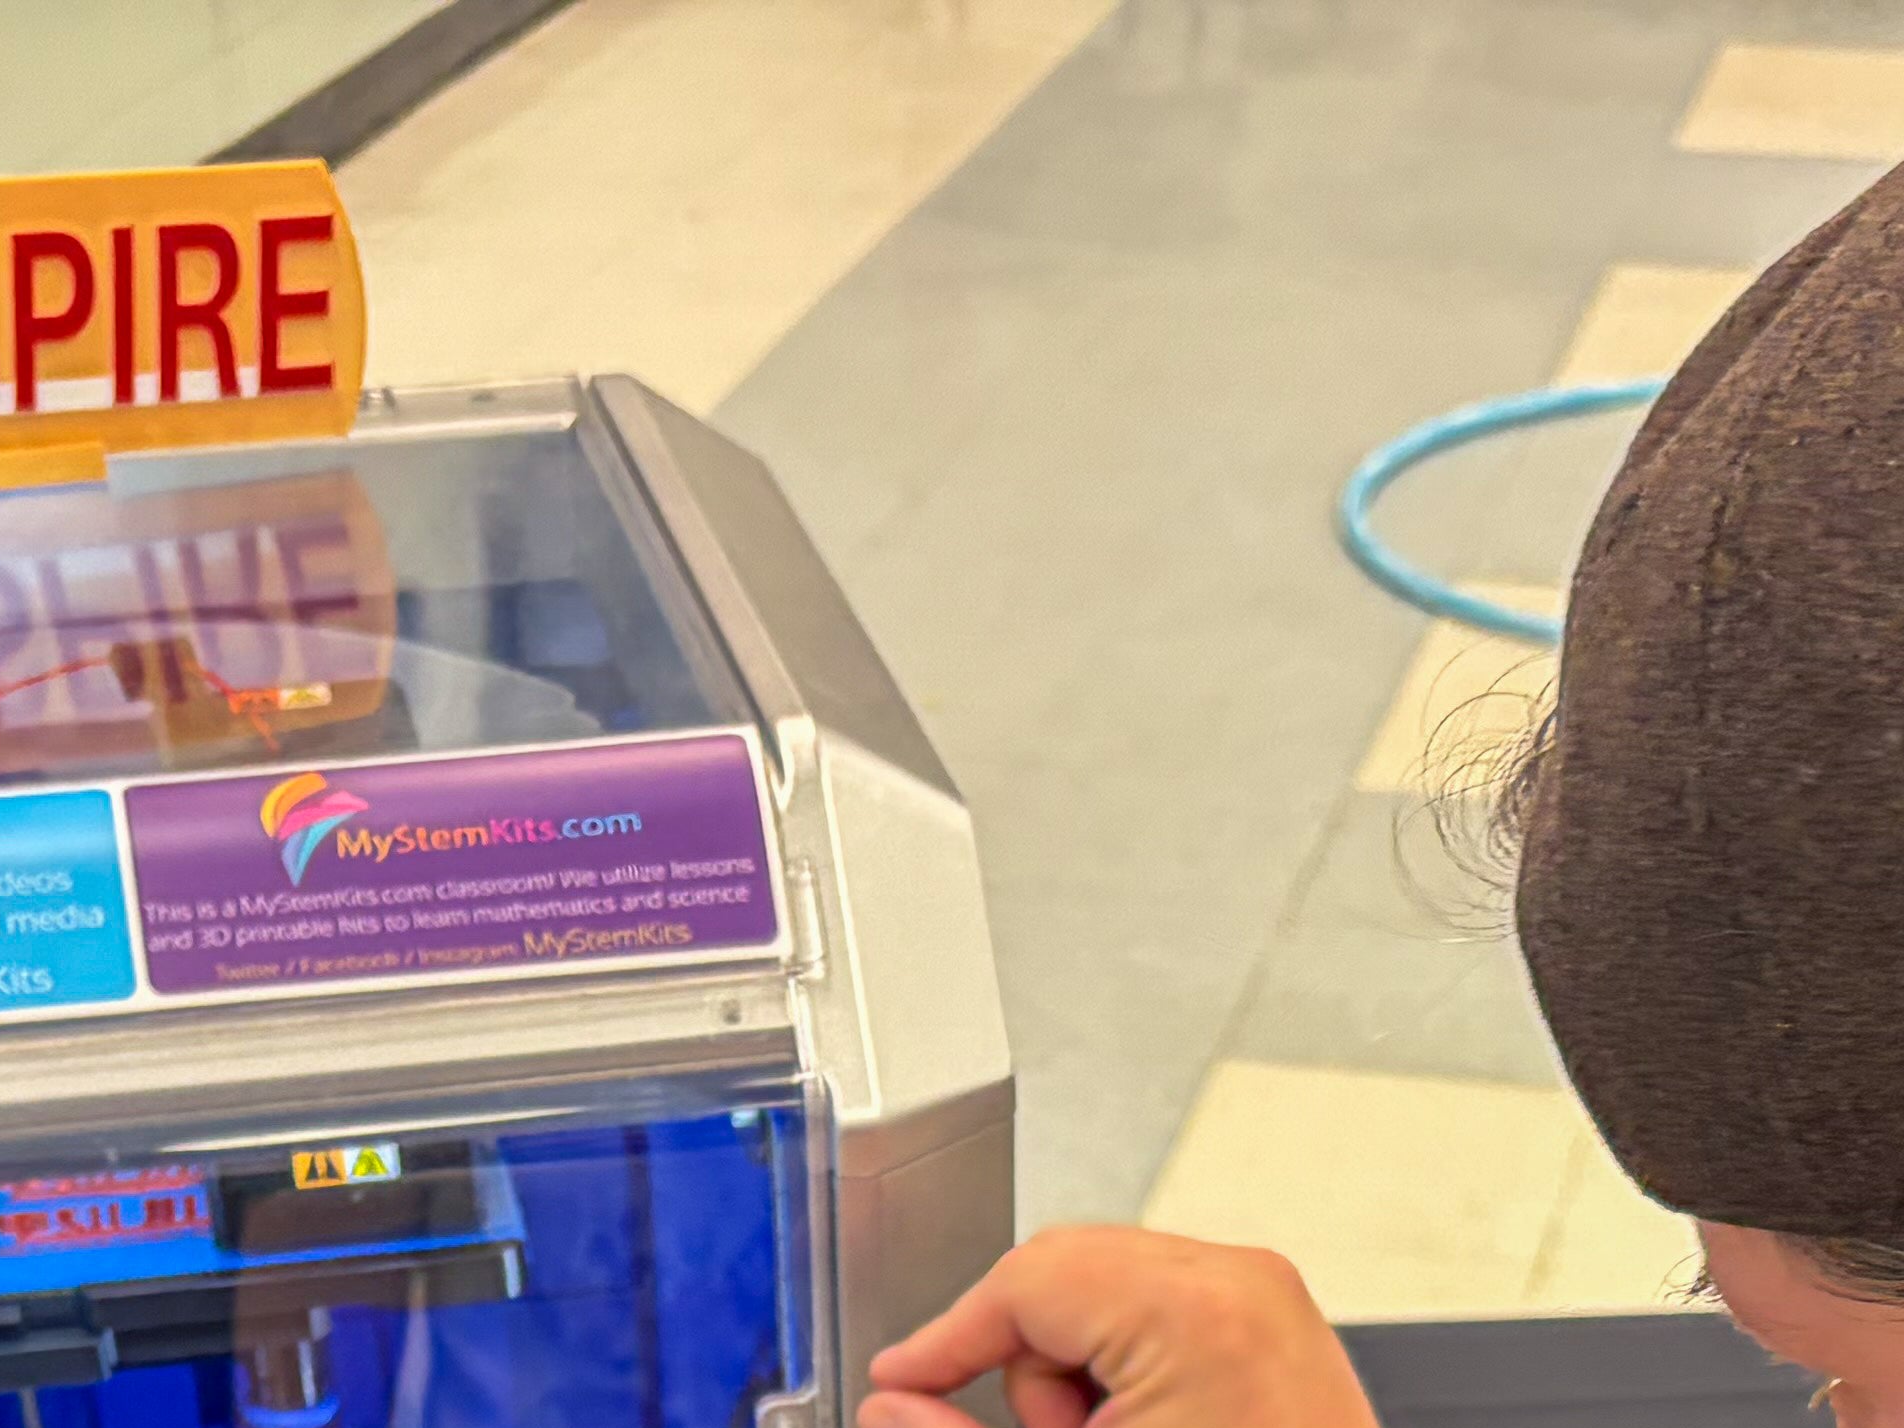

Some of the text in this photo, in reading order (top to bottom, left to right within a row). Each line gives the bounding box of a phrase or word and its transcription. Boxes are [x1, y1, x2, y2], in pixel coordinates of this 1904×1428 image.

[337, 810, 643, 864] MyStemKits.com
[144, 904, 193, 923] This
[196, 900, 218, 919] is
[222, 902, 238, 919] a
[559, 869, 597, 890] We
[600, 863, 666, 887] utilize
[669, 857, 755, 880] lessons
[7, 903, 105, 934] media
[147, 930, 193, 952] and
[197, 925, 233, 948] 3D
[235, 917, 337, 948] printable
[384, 915, 410, 934] to
[412, 909, 470, 930] learn
[472, 894, 617, 925] mathematics
[621, 892, 664, 913] and
[668, 884, 752, 908] science
[523, 922, 694, 959] MyStemKits
